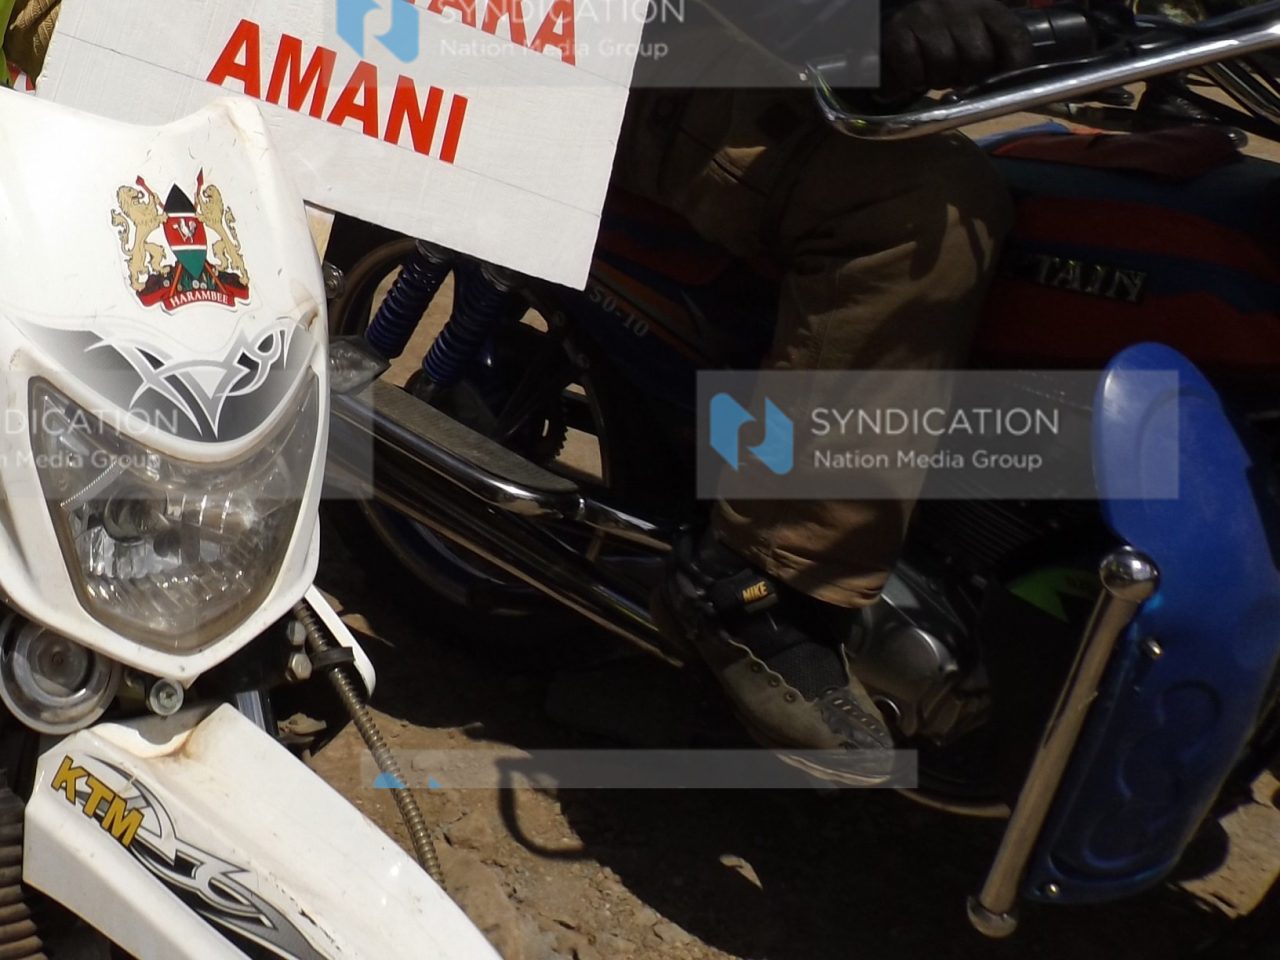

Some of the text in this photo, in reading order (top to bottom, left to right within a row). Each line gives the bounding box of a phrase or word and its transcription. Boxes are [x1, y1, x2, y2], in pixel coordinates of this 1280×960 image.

[206, 19, 469, 166] AMANI
[169, 290, 228, 307] HARAMBEE
[51, 754, 145, 847] KTM
